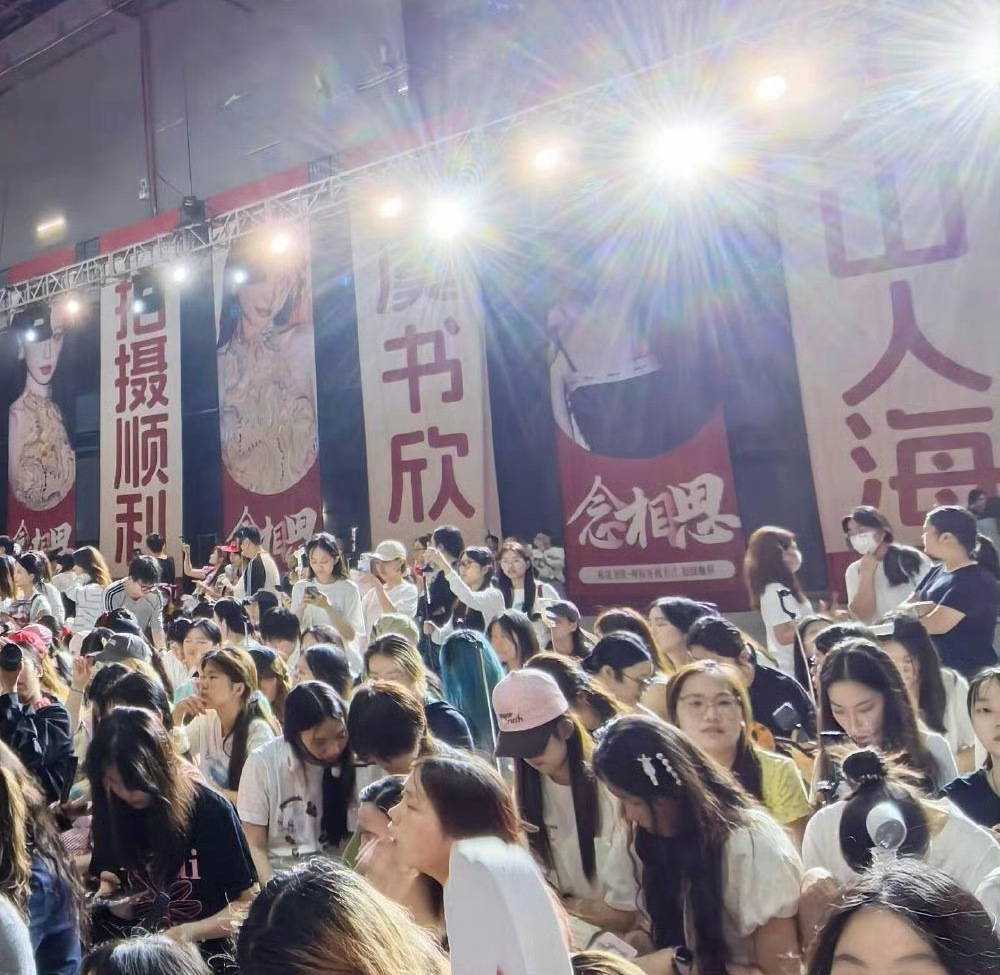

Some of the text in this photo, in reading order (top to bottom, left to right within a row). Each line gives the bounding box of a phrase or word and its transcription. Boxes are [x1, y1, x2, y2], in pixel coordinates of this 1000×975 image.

[114, 280, 169, 565] 拍摄顺利
[818, 115, 1000, 528] 山人海
[566, 472, 743, 550] 念相思
